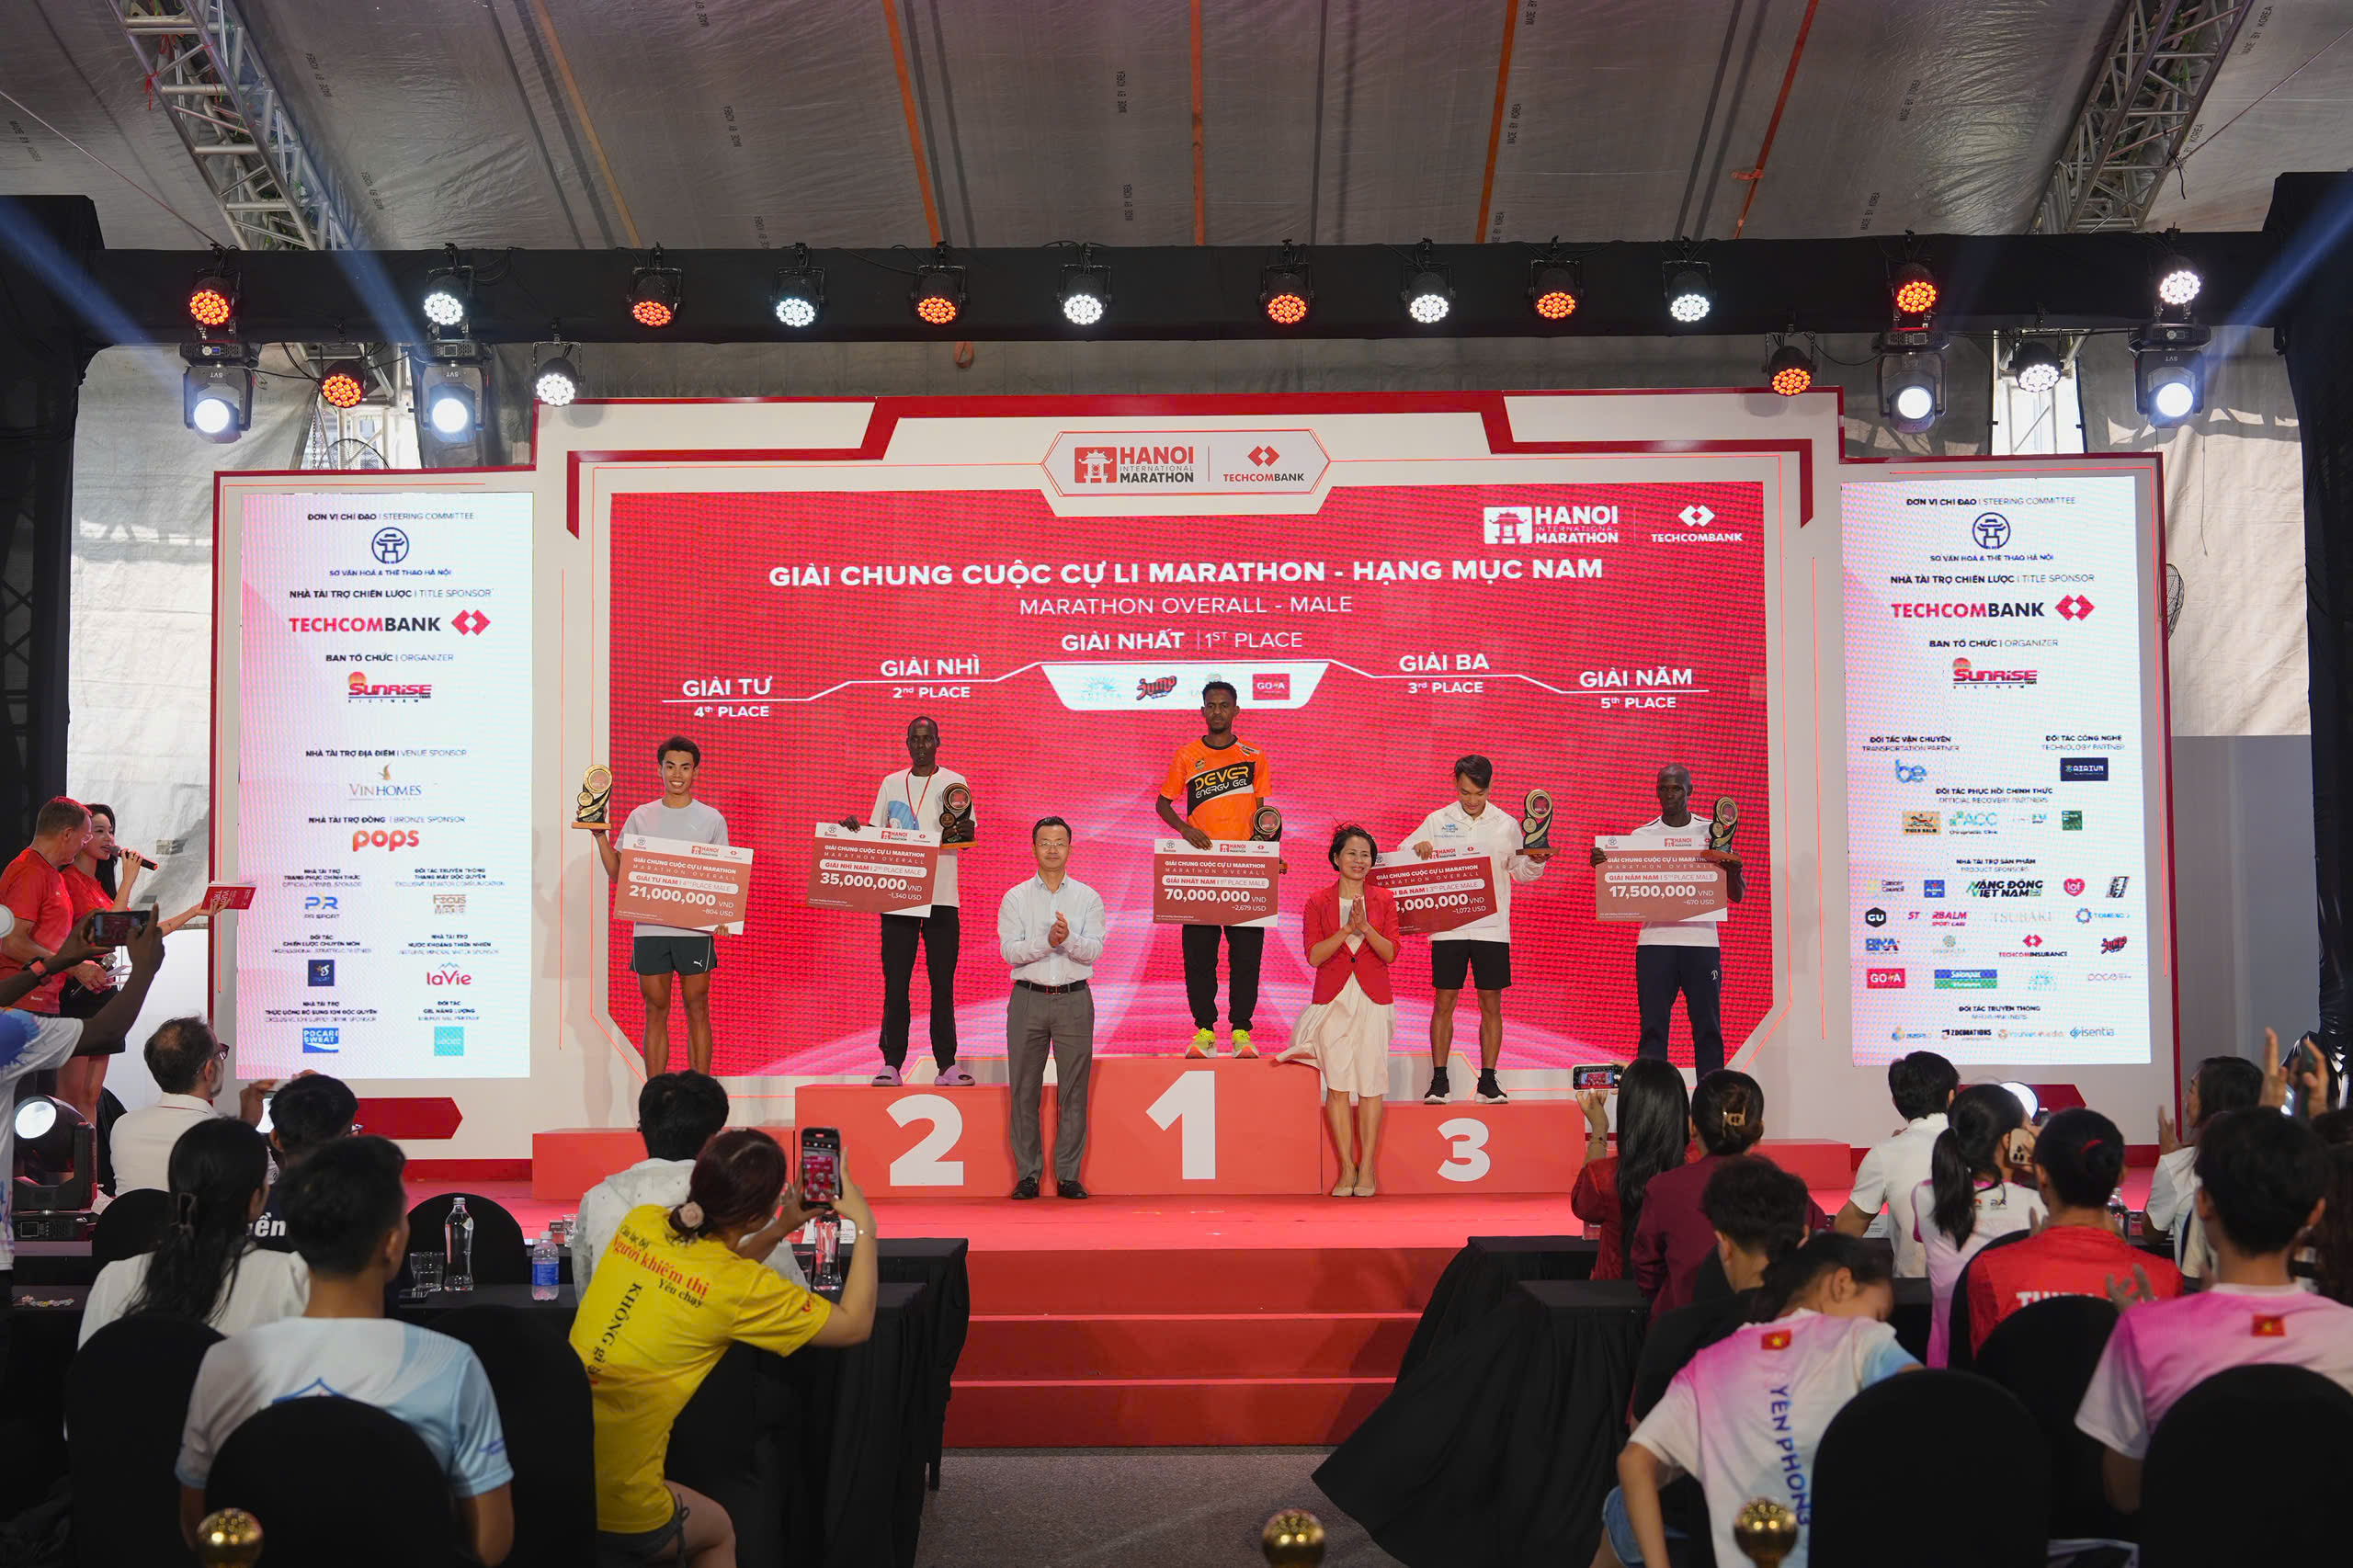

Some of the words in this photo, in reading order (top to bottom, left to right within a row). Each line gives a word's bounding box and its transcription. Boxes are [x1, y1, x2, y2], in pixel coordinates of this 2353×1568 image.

[2257, 6, 2273, 28] KOREA
[1120, 447, 1194, 464] HANOI
[1120, 472, 1194, 483] MARATHON
[1223, 473, 1304, 482] TECHCOMBANK
[1535, 506, 1618, 525] HANOI
[1535, 532, 1618, 543] MARATHON
[1651, 532, 1743, 542] TECHCOMBANK
[769, 561, 830, 586] GIẢI
[840, 565, 952, 585] CHUNG
[962, 560, 1051, 589] CUỘC
[1061, 561, 1106, 588] CỰ
[1115, 563, 1139, 583] LI
[1149, 562, 1325, 583] MARATHON
[1354, 561, 1442, 585] HẠNG
[1452, 559, 1523, 584] MỤC
[1532, 559, 1603, 579] NAM
[1891, 574, 1912, 584] NHÀ
[1915, 574, 1929, 584] TÀI
[1933, 575, 1952, 585] TRỢ
[1988, 575, 2015, 584] LƯỢC
[290, 588, 311, 597] NHÀ
[313, 588, 328, 597] TÀI
[331, 589, 350, 599] TRỢ
[385, 589, 412, 598] LƯỢC
[419, 589, 443, 597] TITLE
[446, 588, 491, 597] SPONSOR
[1019, 598, 1154, 615] MARATHON
[1162, 597, 1267, 614] OVERALL
[1290, 597, 1353, 612] MALE
[1892, 602, 2045, 618] TECHCOMBANK
[290, 617, 441, 632] TECHCOMBANK
[1062, 631, 1110, 651] GIẢI
[1118, 629, 1185, 649] NHẤT
[1205, 632, 1227, 648] 1ST
[1235, 632, 1302, 648] PLACE
[365, 653, 393, 662] CHỨC
[881, 658, 928, 676] GIẢI
[937, 653, 980, 675] NHÌ
[1399, 652, 1448, 672] GIẢI
[1456, 653, 1489, 670] BA
[1580, 667, 1628, 687] GIẢI
[1636, 666, 1692, 685] NĂM
[683, 676, 731, 697] GIẢI
[738, 676, 773, 695] TƯ
[892, 687, 914, 698] 2nd
[919, 687, 971, 698] PLACE
[1407, 682, 1427, 693] 3rd
[1432, 681, 1483, 693] PLACE
[1601, 698, 1620, 709] 5th
[1625, 698, 1677, 708] PLACE
[694, 706, 713, 717] 4th
[718, 706, 769, 717] PLACE
[340, 750, 357, 758] TRỢ
[1895, 759, 1927, 783] be
[349, 784, 422, 796] VINHOMES
[1196, 782, 1229, 799] ENERGY
[353, 830, 419, 852] pops
[824, 852, 875, 860] MARATHON
[820, 873, 907, 891] 35,000,000
[1439, 883, 1459, 892] PLACE
[629, 885, 716, 906] 21,000,000
[1164, 889, 1250, 903] 70,000,000
[1609, 885, 1696, 899] 17,500,000
[426, 971, 472, 985] laVie
[2082, 1027, 2114, 1037] isentia
[1146, 1071, 1215, 1180] 1
[886, 1094, 963, 1187] 2
[1437, 1119, 1490, 1182] 3
[602, 1283, 642, 1346] KHÔNG
